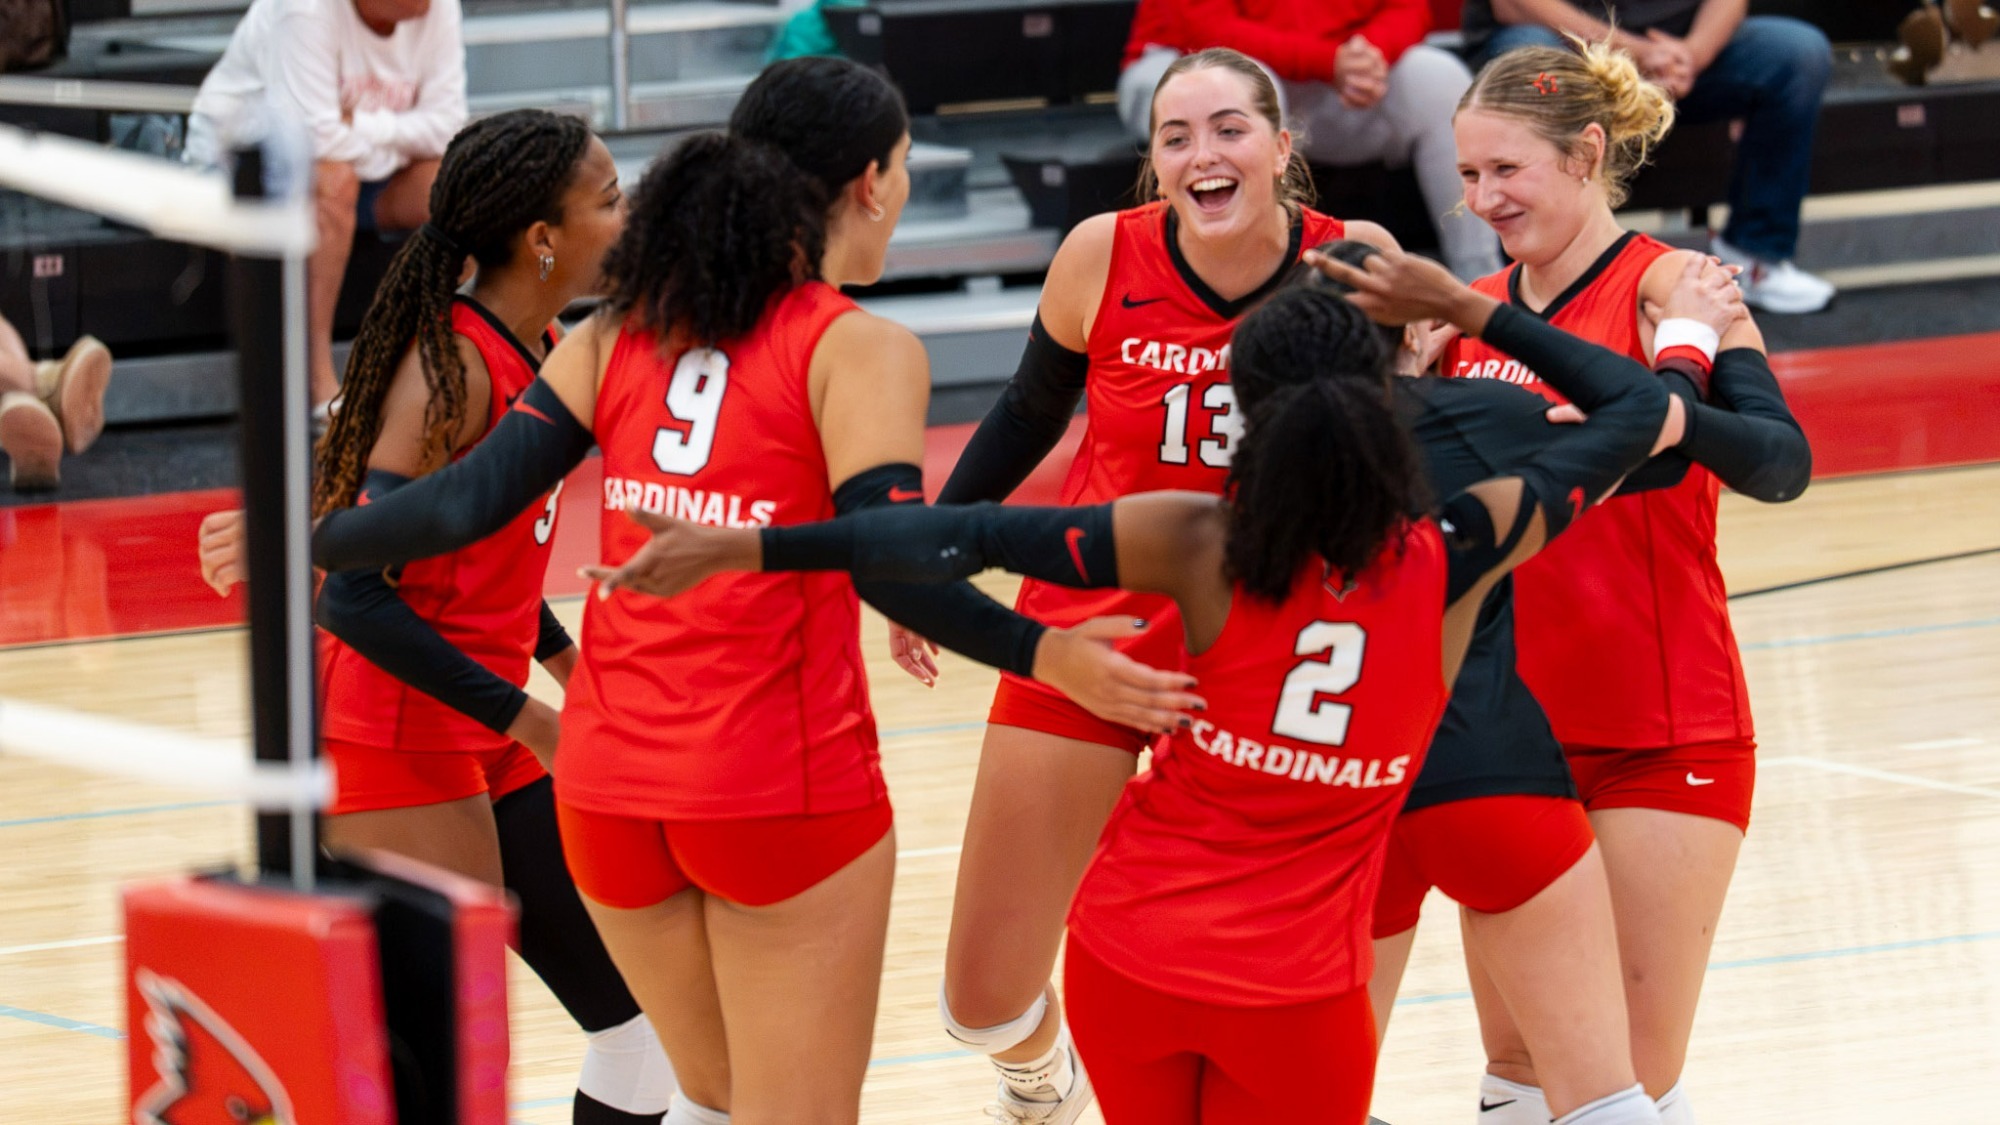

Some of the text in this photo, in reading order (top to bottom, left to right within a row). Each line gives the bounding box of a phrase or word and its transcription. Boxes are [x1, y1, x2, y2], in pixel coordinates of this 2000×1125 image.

[651, 347, 731, 477] 9
[1158, 382, 1246, 468] 13
[1270, 618, 1367, 748] 2
[1191, 718, 1411, 789] CARDINALS
